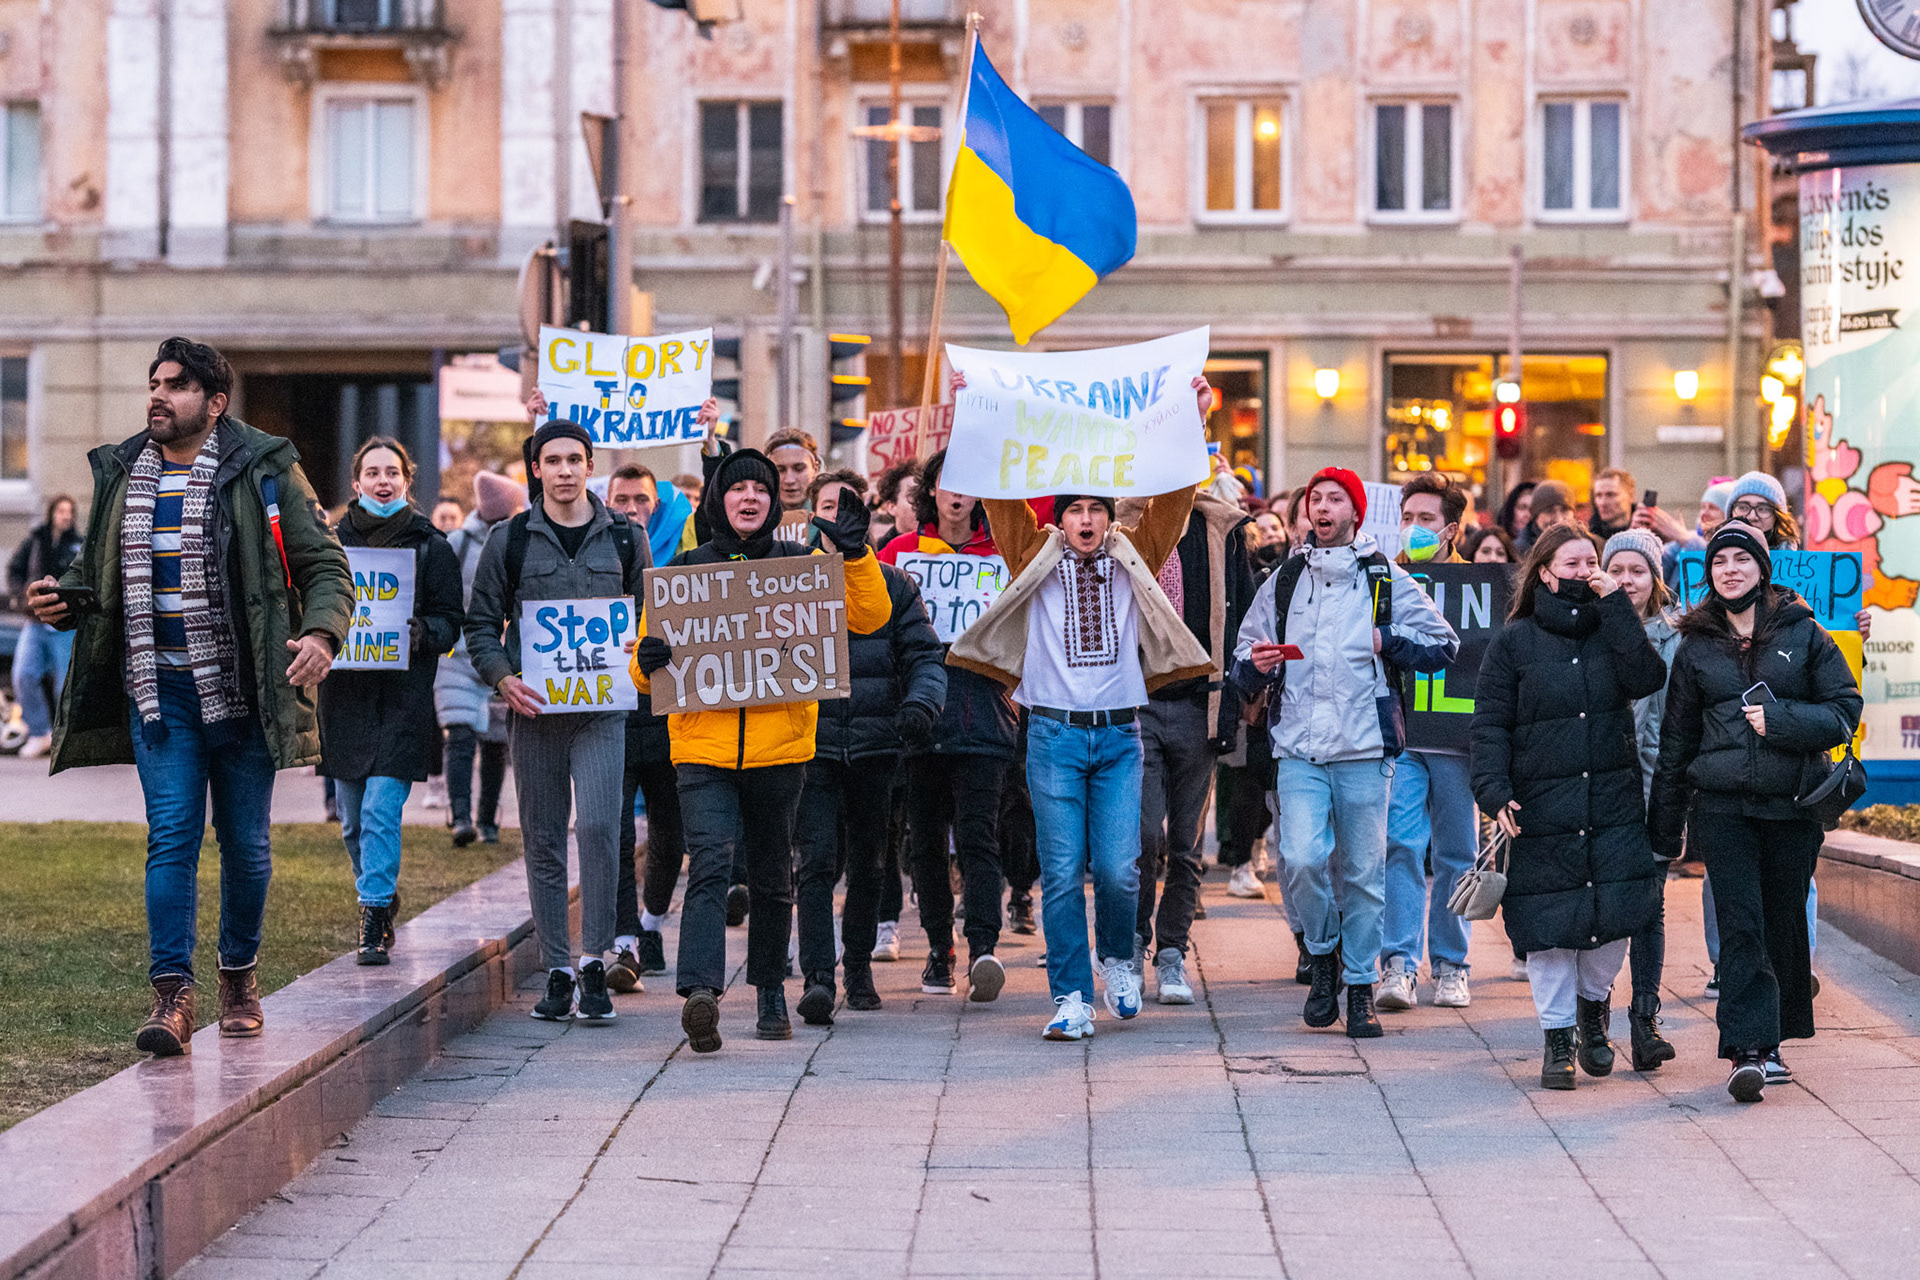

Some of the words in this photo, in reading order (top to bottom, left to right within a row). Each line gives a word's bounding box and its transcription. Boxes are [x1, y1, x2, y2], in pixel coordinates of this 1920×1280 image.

[549, 337, 710, 380] GLORY
[593, 380, 648, 410] TO
[991, 365, 1171, 420] UKRAINE
[872, 413, 896, 437] NO
[1016, 399, 1139, 454] WANTS
[1000, 438, 1135, 490] PEACE
[653, 570, 735, 609] DON'T
[747, 564, 830, 598] touch
[903, 559, 974, 589] STOP
[976, 562, 1012, 592] PU
[1771, 553, 1817, 586] arts
[661, 612, 749, 647] WHAT
[754, 600, 845, 640] ISN'T
[338, 631, 399, 662] AINE
[546, 674, 614, 705] WAR
[665, 636, 837, 708] YOUR'S!
